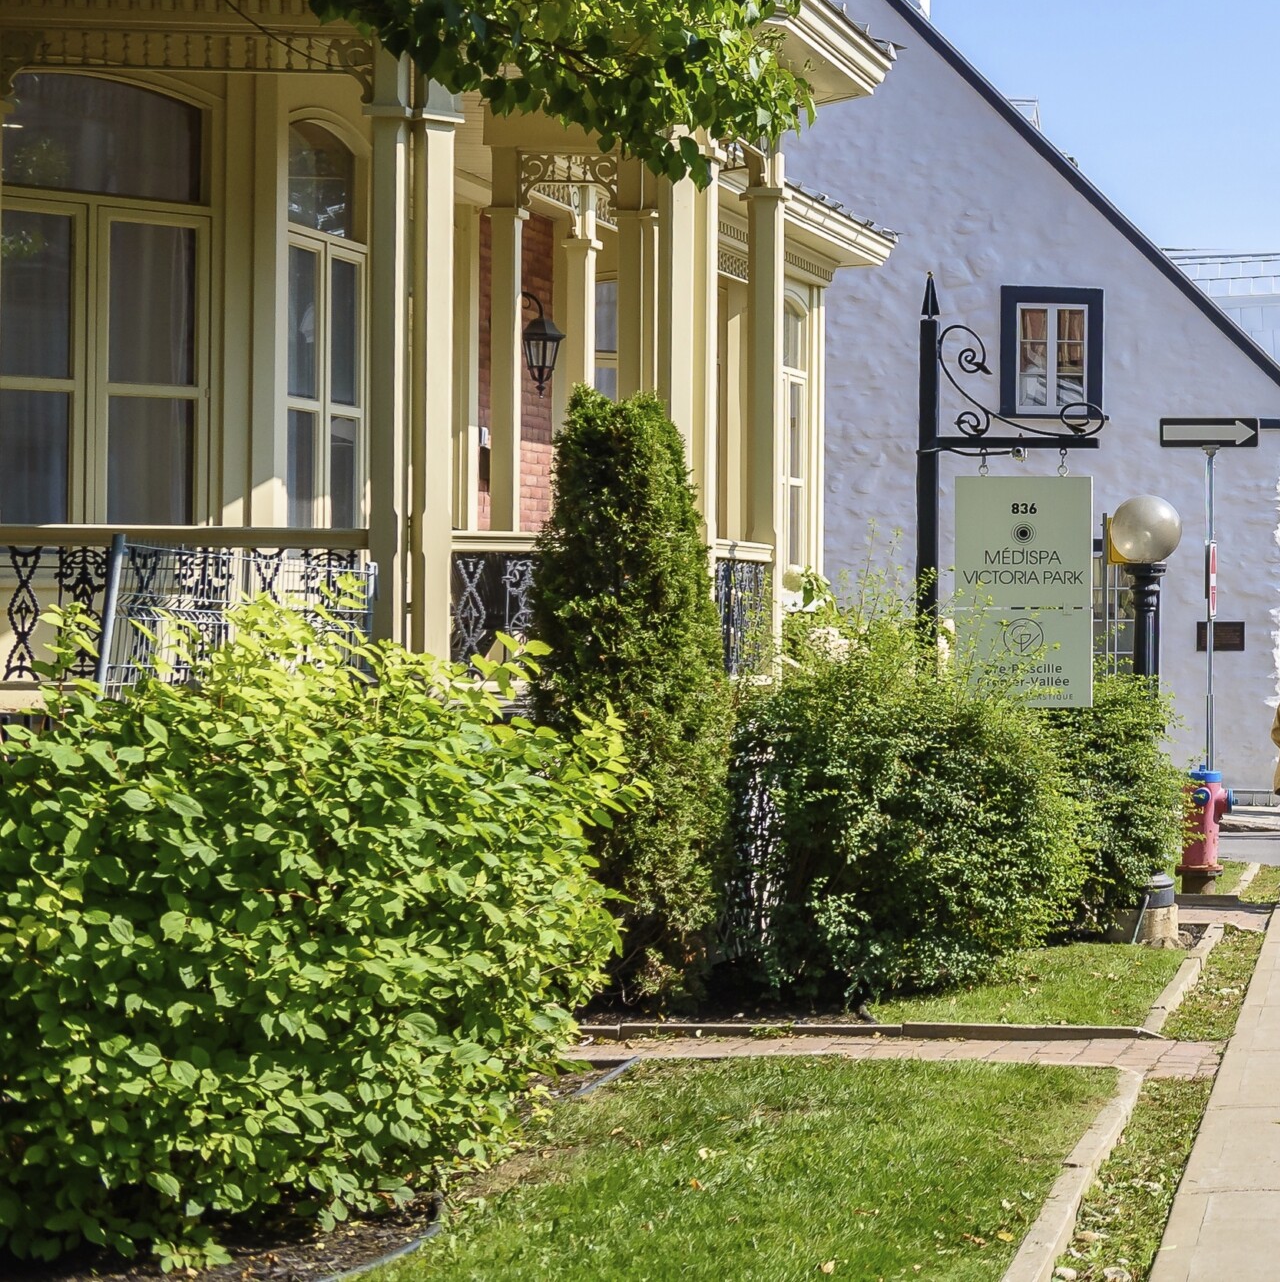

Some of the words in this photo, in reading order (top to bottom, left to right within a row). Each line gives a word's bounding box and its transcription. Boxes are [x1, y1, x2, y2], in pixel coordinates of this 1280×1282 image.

[1011, 503, 1037, 515] 836
[984, 547, 1062, 565] MÉDISPA
[963, 570, 1040, 585] VICTORIA
[1043, 570, 1084, 585] PARK
[1011, 664, 1063, 674] Pscille
